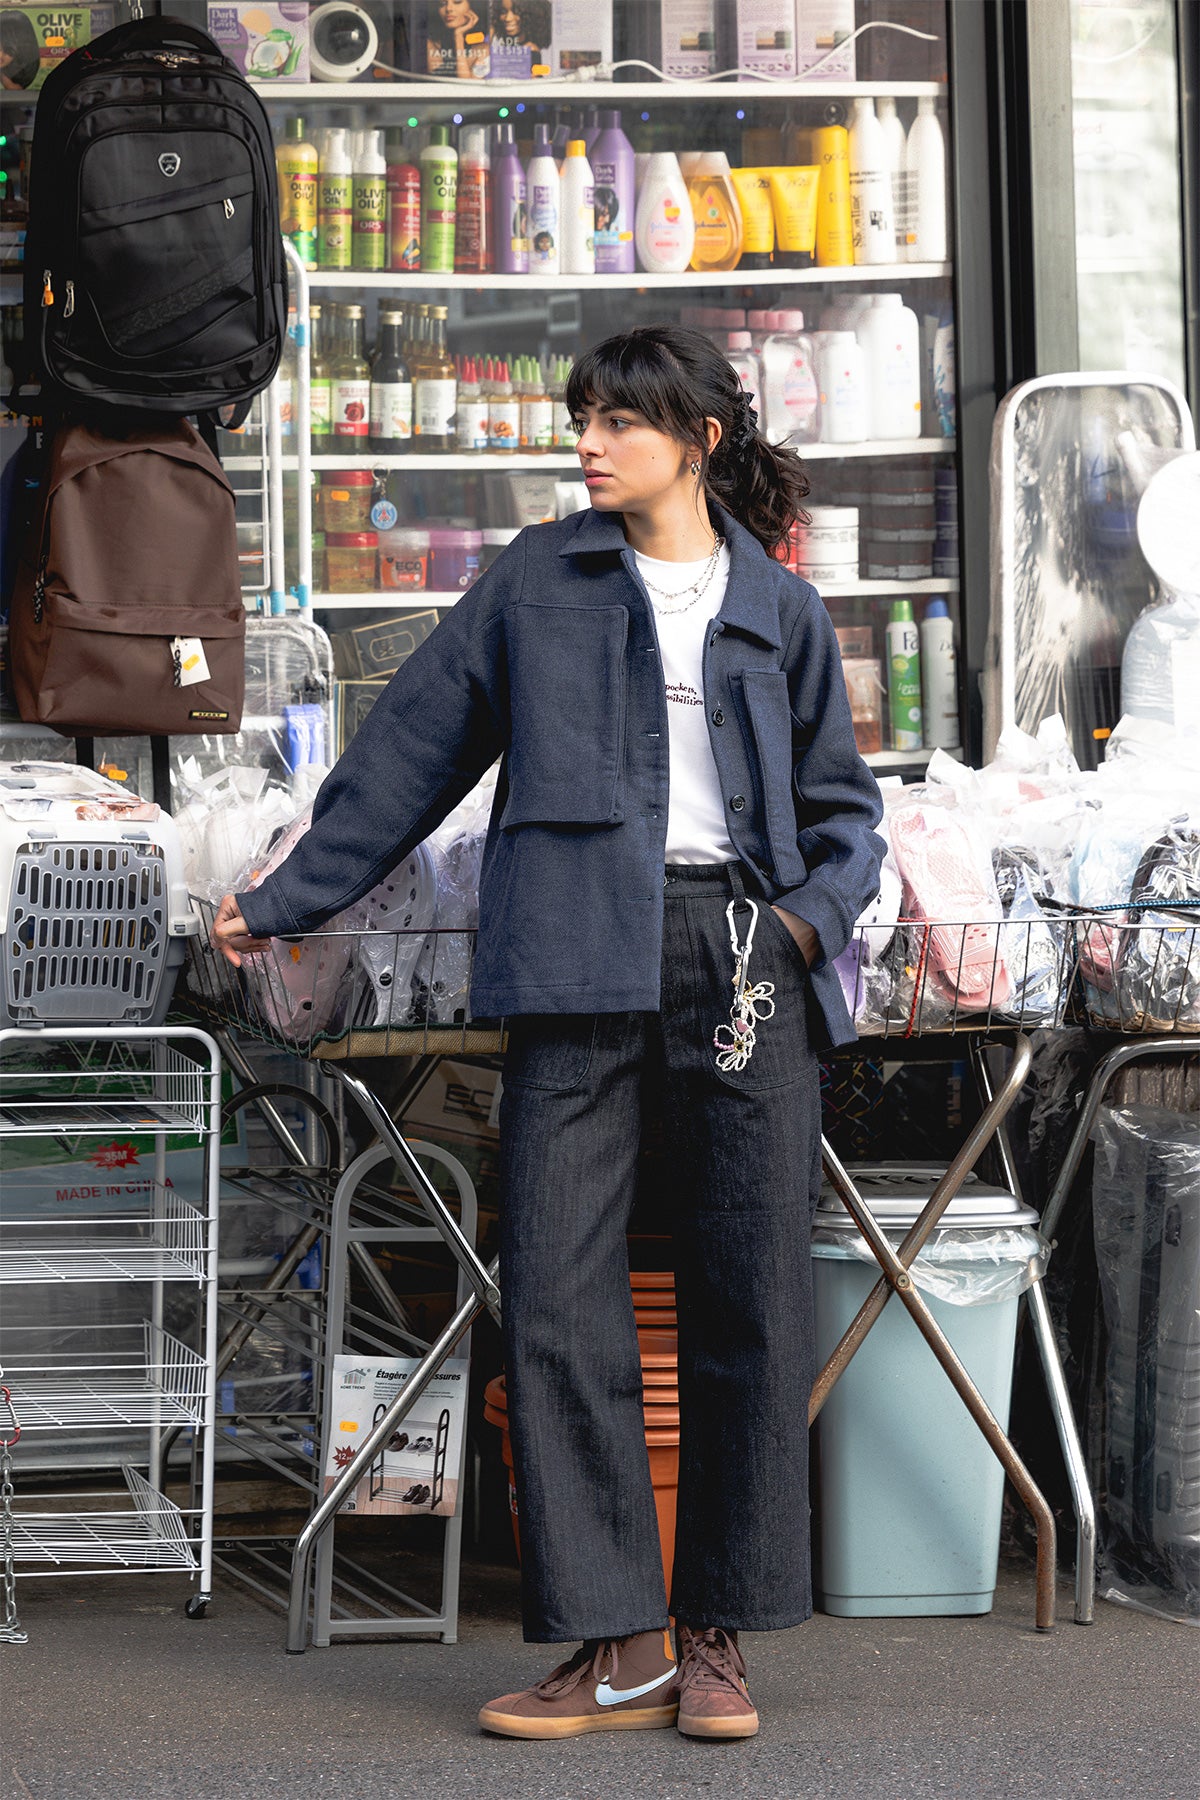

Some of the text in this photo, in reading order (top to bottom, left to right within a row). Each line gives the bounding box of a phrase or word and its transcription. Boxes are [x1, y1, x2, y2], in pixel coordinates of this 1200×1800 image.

[36, 13, 82, 27] OLIVE
[429, 49, 488, 59] FADE RESIST
[493, 46, 529, 56] RESIST
[355, 188, 386, 200] OLIVE
[325, 196, 341, 205] OIL
[358, 199, 375, 210] OIL
[395, 561, 421, 571] ECO
[903, 630, 920, 651] Fa
[56, 1187, 101, 1202] MADE
[106, 1186, 121, 1196] IN
[376, 1369, 408, 1381] Étagère
